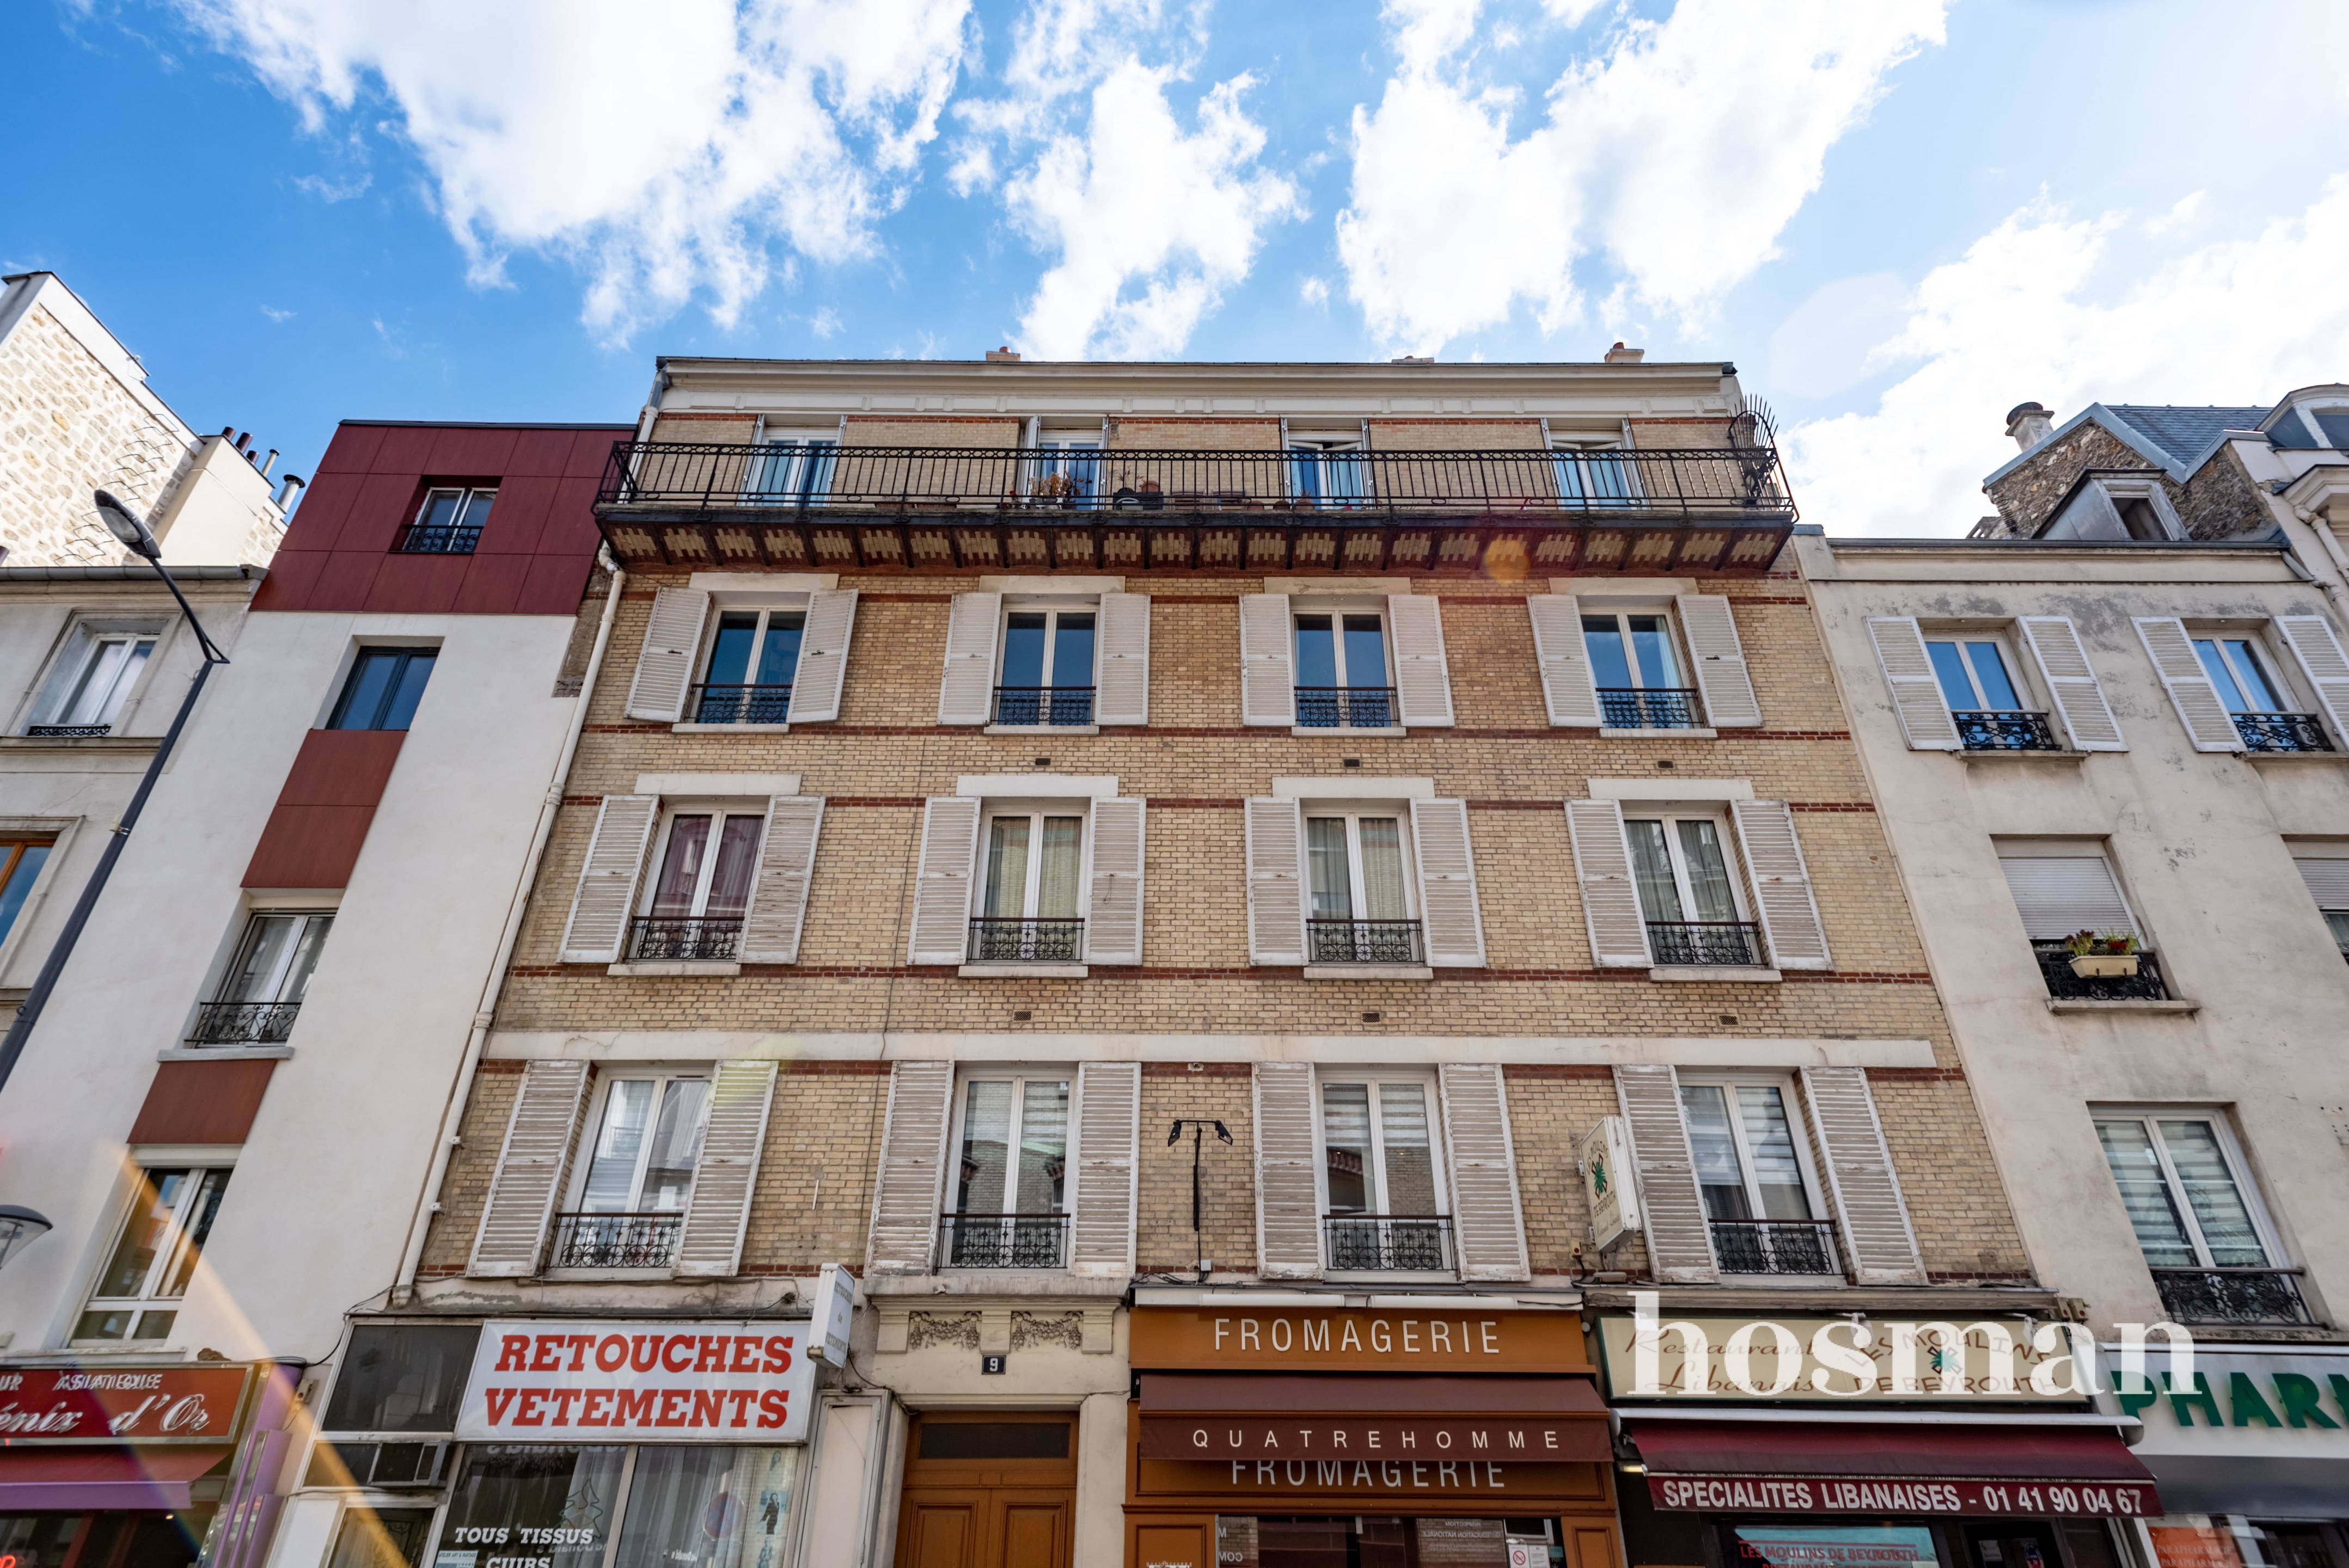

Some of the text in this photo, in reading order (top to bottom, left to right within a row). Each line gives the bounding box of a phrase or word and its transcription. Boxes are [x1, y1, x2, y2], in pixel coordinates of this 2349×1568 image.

[1215, 1318, 1500, 1354] FROMAGERIE
[1625, 1326, 1817, 1355] Restaurant
[1844, 1329, 2051, 1368] LES MOULINS
[494, 1334, 794, 1374] RETOUCHES
[989, 1358, 998, 1371] 9
[53, 1372, 163, 1391] ASIATIQUE
[1644, 1360, 1814, 1392] Libanais
[1854, 1376, 2060, 1394] DE BEYROUTH
[485, 1388, 789, 1429] VETEMENTS
[1193, 1429, 1559, 1449] QUATREHOMME
[1232, 1460, 1505, 1488] FROMAGERIE
[1663, 1480, 1813, 1509] SPECIALITES
[1823, 1483, 1961, 1512] LIBANAISES
[1983, 1485, 2011, 1512] 01
[2018, 1486, 2045, 1512] 41
[2048, 1486, 2079, 1513] 90
[2083, 1487, 2113, 1514] 04
[2116, 1488, 2142, 1515] 67
[455, 1527, 594, 1545] TOUS TISSUS
[1740, 1546, 1919, 1563] LES MOULINS DE BEYROUTH
